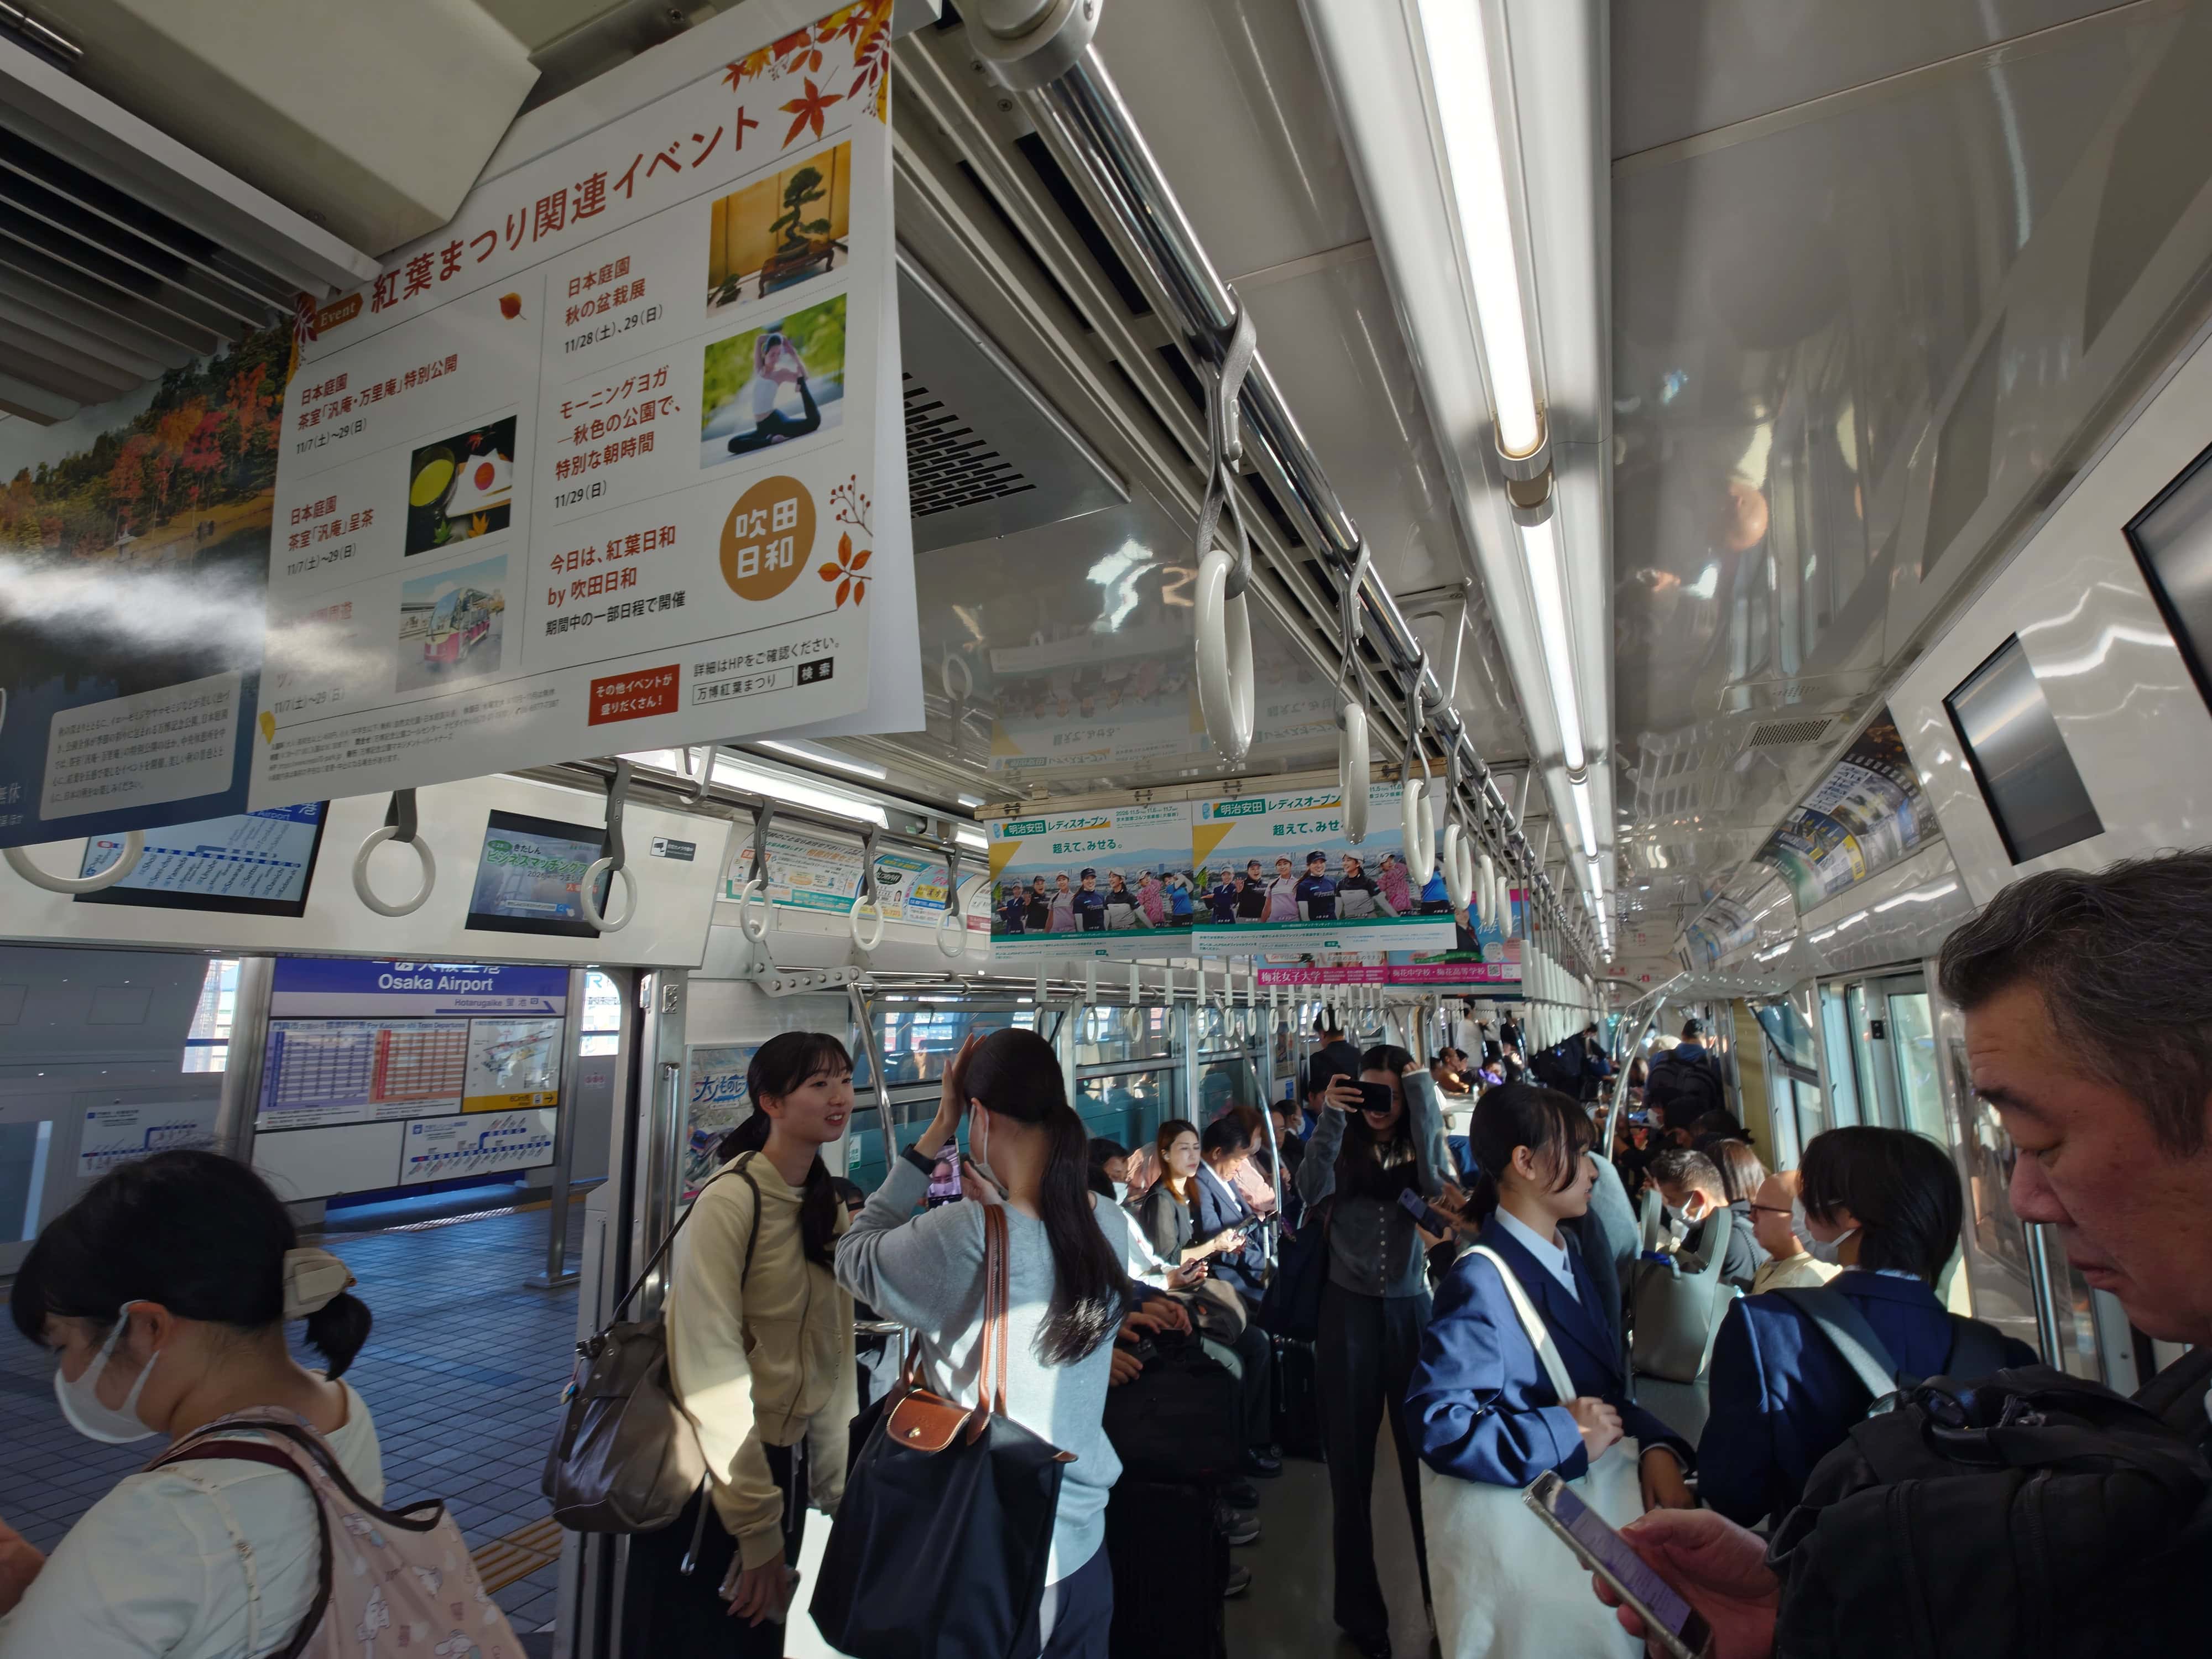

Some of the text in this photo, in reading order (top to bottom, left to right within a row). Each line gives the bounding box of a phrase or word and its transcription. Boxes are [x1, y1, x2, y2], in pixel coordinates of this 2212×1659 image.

[371, 106, 760, 314] 紅葉まつり関連イベント
[568, 256, 630, 298] 日本庭園
[320, 301, 356, 328] Event
[565, 278, 645, 327] 秋の盆栽展
[301, 373, 348, 406] 日本庭園
[559, 365, 669, 420] モーニングヨガ
[555, 431, 654, 481] 特別な朝時間
[555, 479, 607, 508] 11/29(日)
[290, 495, 337, 526] 日本庭園
[735, 497, 798, 539] 吹田
[550, 525, 676, 576] 今日は、紅葉日和
[737, 535, 794, 579] 日和
[548, 566, 637, 609] by 吹田日和
[545, 589, 686, 637] 期間中の一部日程で開催
[693, 637, 839, 677] 詳細はHPをご確認ください。
[596, 673, 672, 698] その他イベントが
[697, 663, 830, 700] 万博紅葉まつり 検索
[1220, 794, 1341, 815] 明治安田 レディスオープン
[1009, 816, 1108, 834] 明治安田 レディスオープン
[1273, 821, 1345, 836] 超えて、みせ
[513, 843, 542, 854] きたしん
[1053, 839, 1123, 854] 超えて、みせる。
[378, 973, 493, 994] Osaka Airport
[1261, 971, 1320, 983] 梅花女子大学
[1392, 968, 1485, 978] 梅花中学校・梅花高等学校
[455, 998, 502, 1008] Hotarugaike
